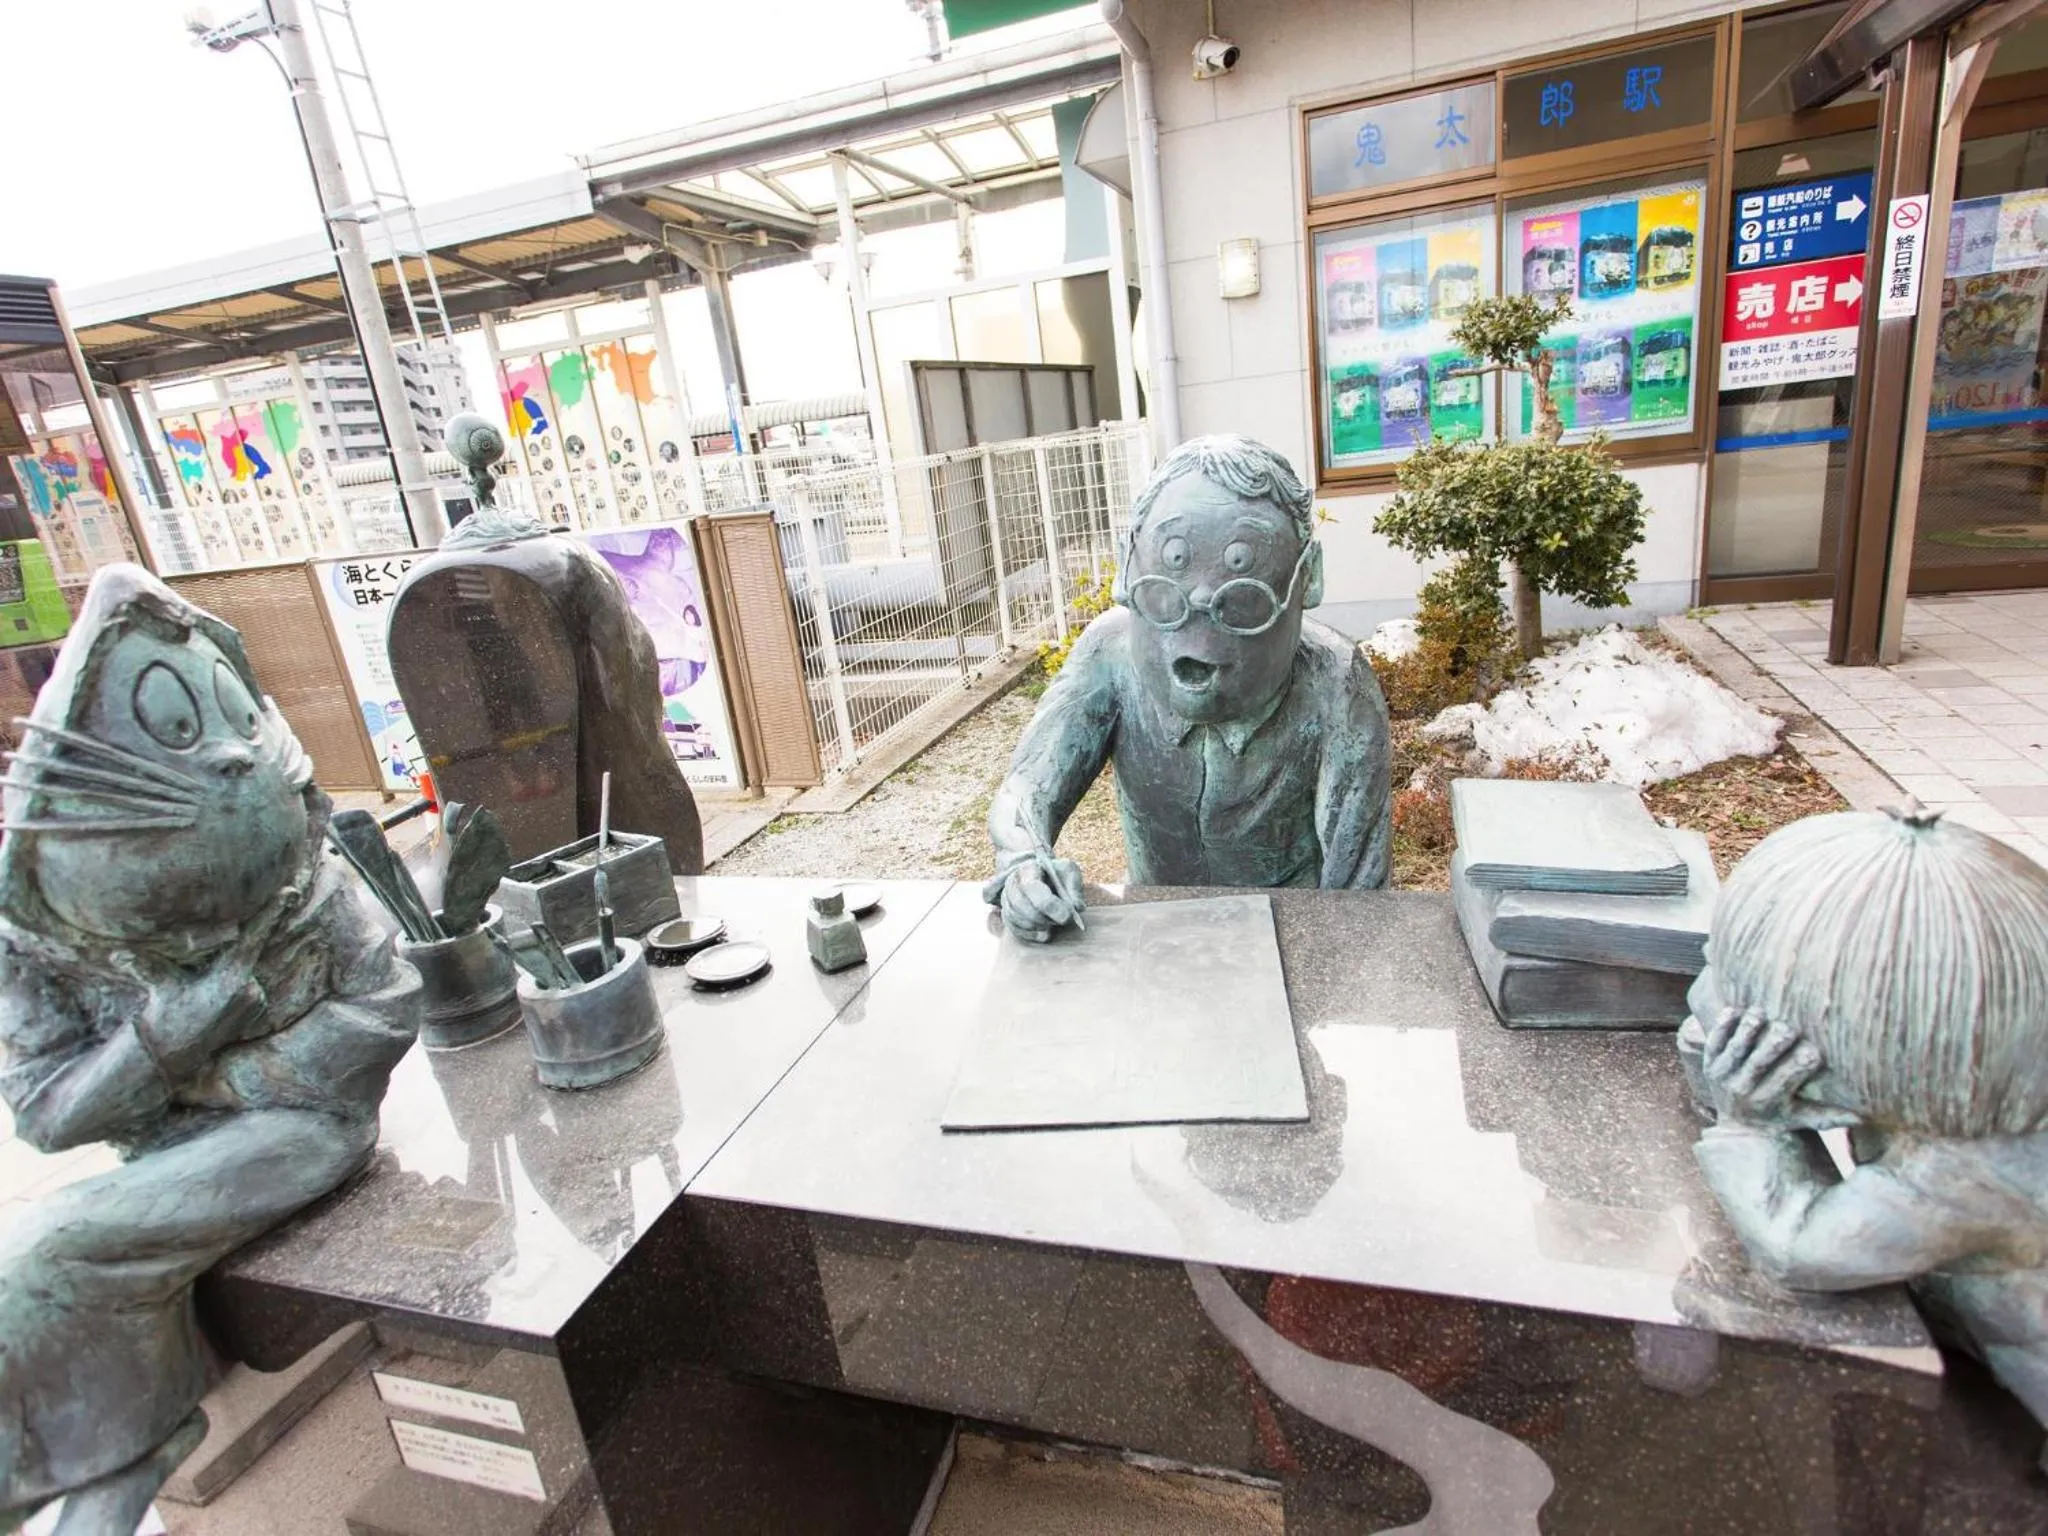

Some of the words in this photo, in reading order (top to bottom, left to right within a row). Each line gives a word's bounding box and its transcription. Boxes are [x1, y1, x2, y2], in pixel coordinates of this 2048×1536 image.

[1354, 65, 1664, 168] 鬼太郎駅
[1890, 234, 1915, 299] 終日禁煙
[1735, 275, 1829, 322] 売店
[353, 588, 395, 606] 日本一
